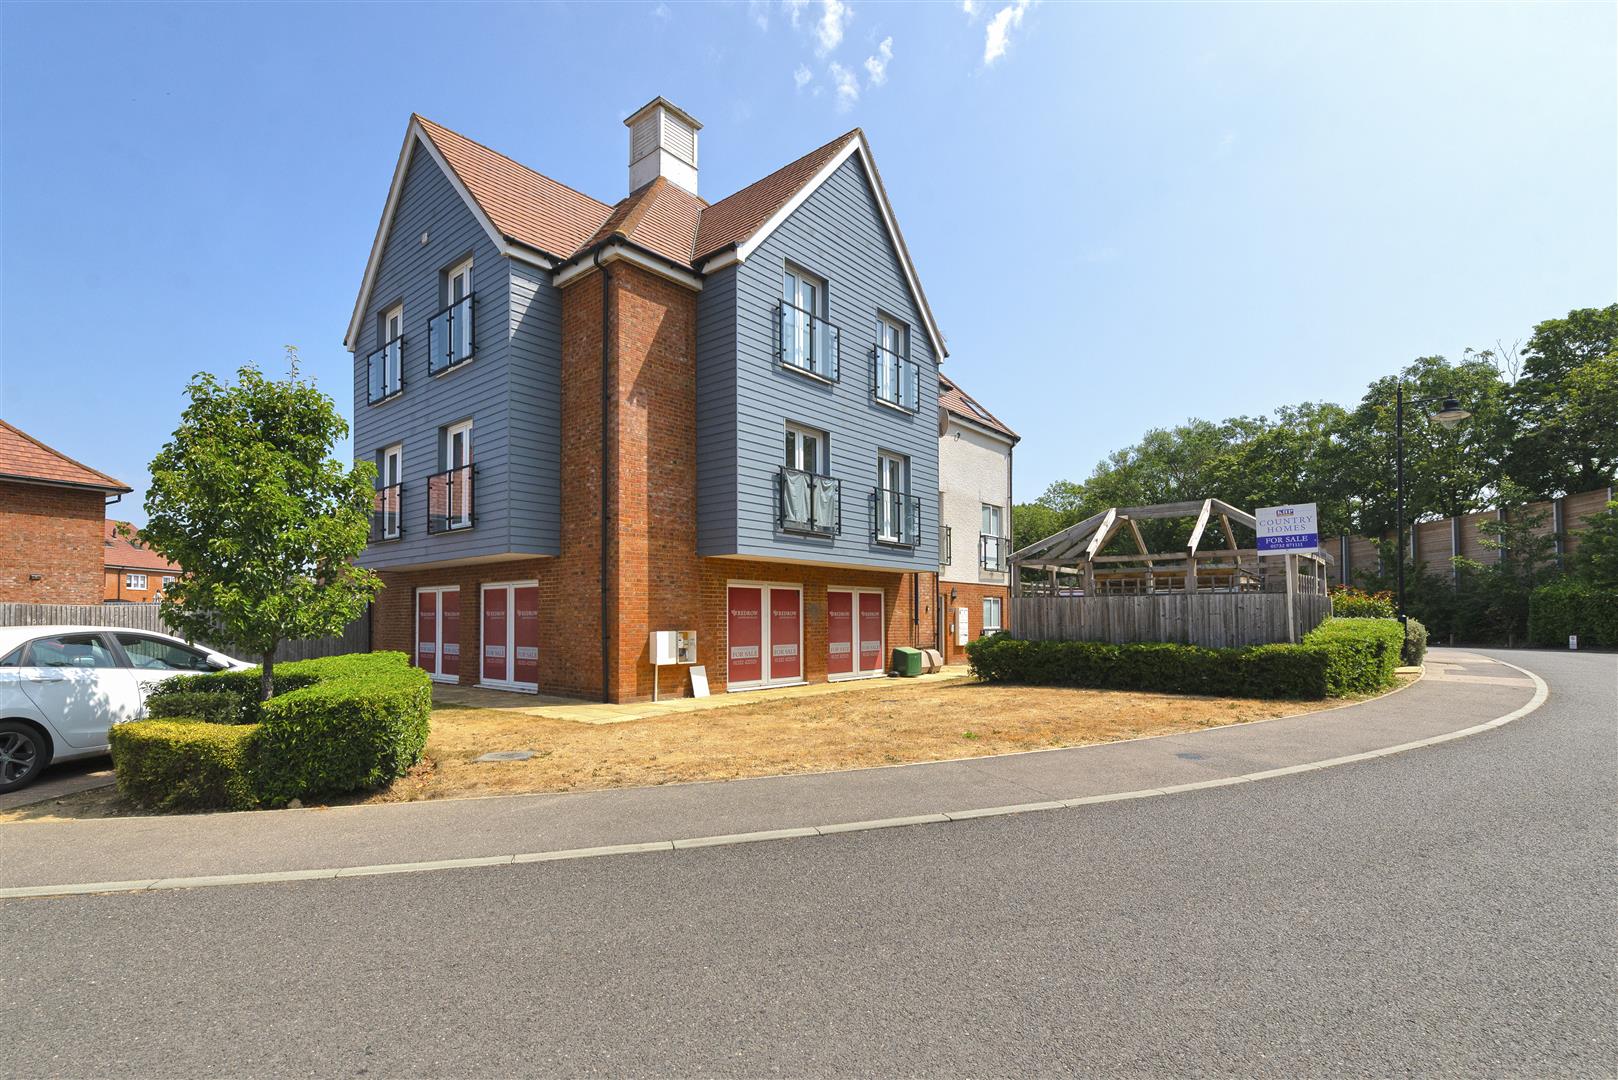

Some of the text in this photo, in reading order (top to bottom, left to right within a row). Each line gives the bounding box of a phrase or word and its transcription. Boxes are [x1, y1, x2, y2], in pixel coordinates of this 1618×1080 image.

[1259, 516, 1312, 526] COUNTRY
[1267, 524, 1306, 533] HOMES
[1265, 535, 1308, 545] FOR SALE
[732, 649, 758, 658] FOR SALE
